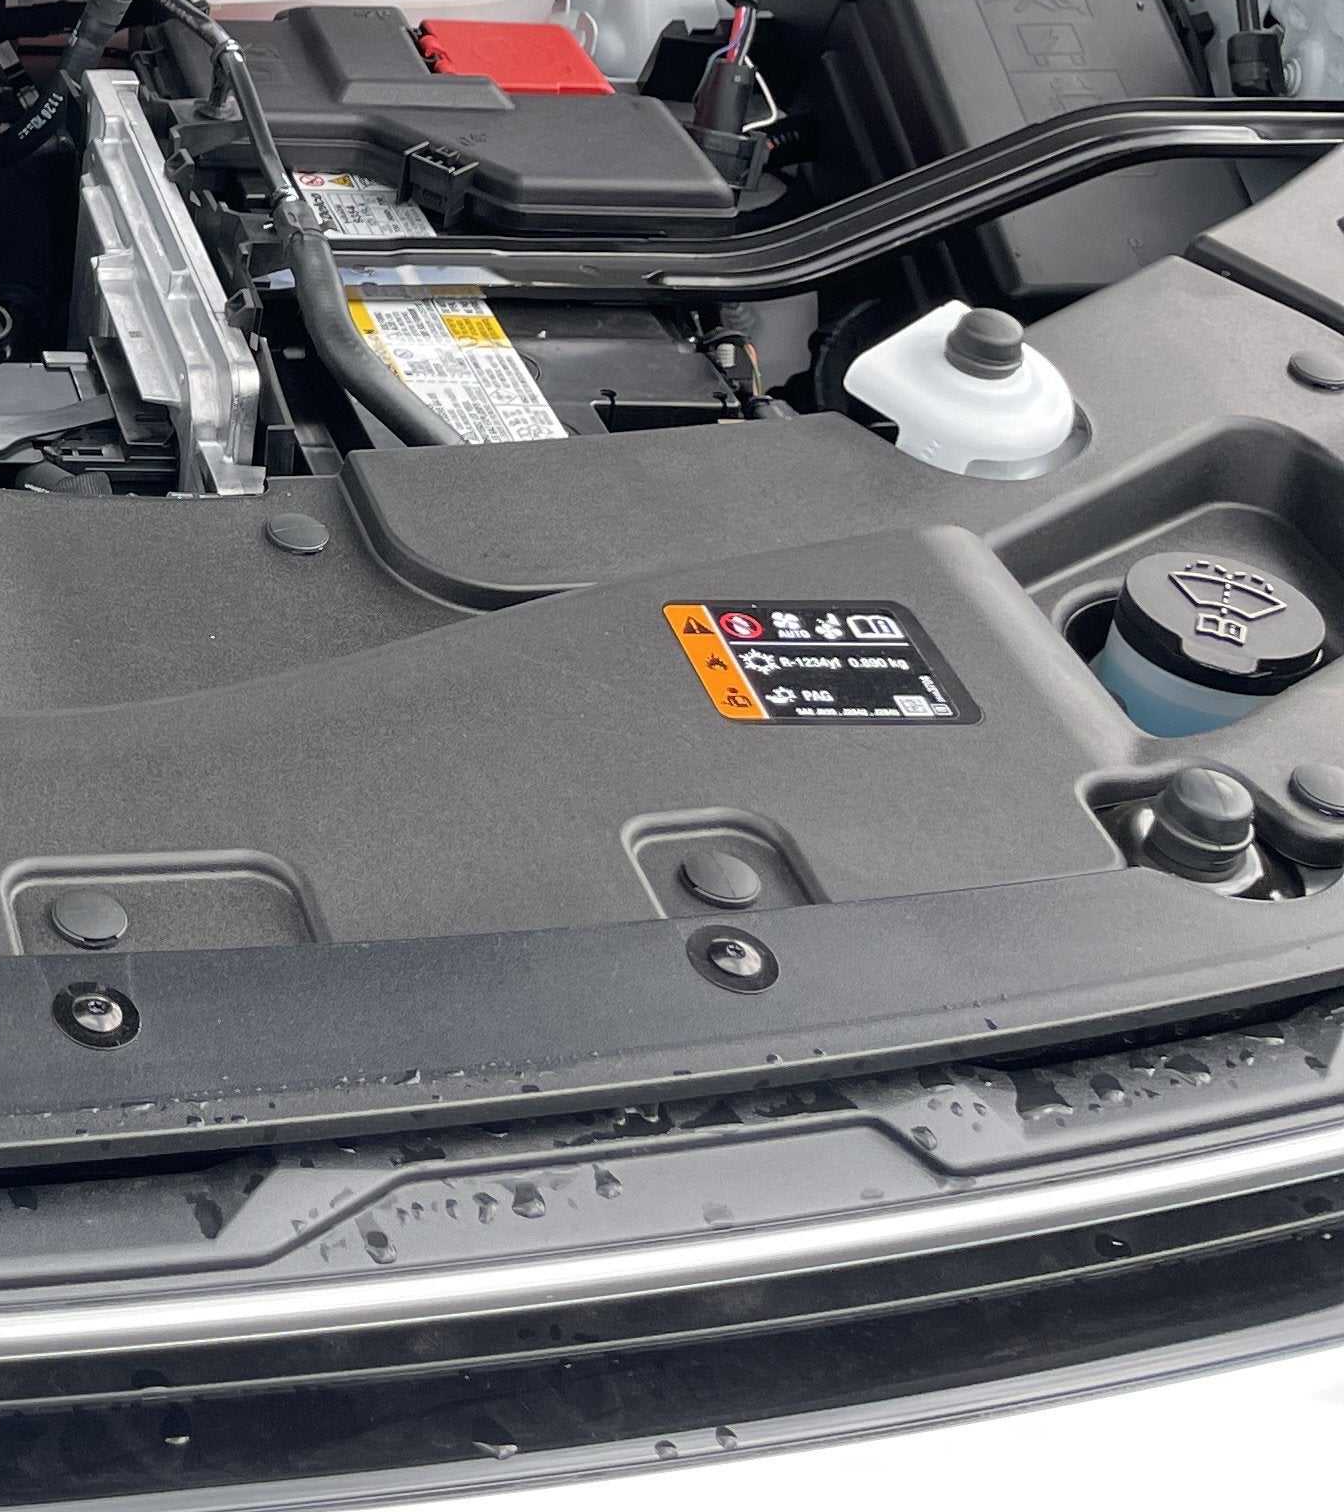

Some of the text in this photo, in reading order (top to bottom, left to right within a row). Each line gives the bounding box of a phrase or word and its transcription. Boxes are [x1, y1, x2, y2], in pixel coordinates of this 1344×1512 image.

[778, 629, 811, 638] AUTO
[887, 657, 910, 671] kg
[802, 690, 834, 702] PAG
